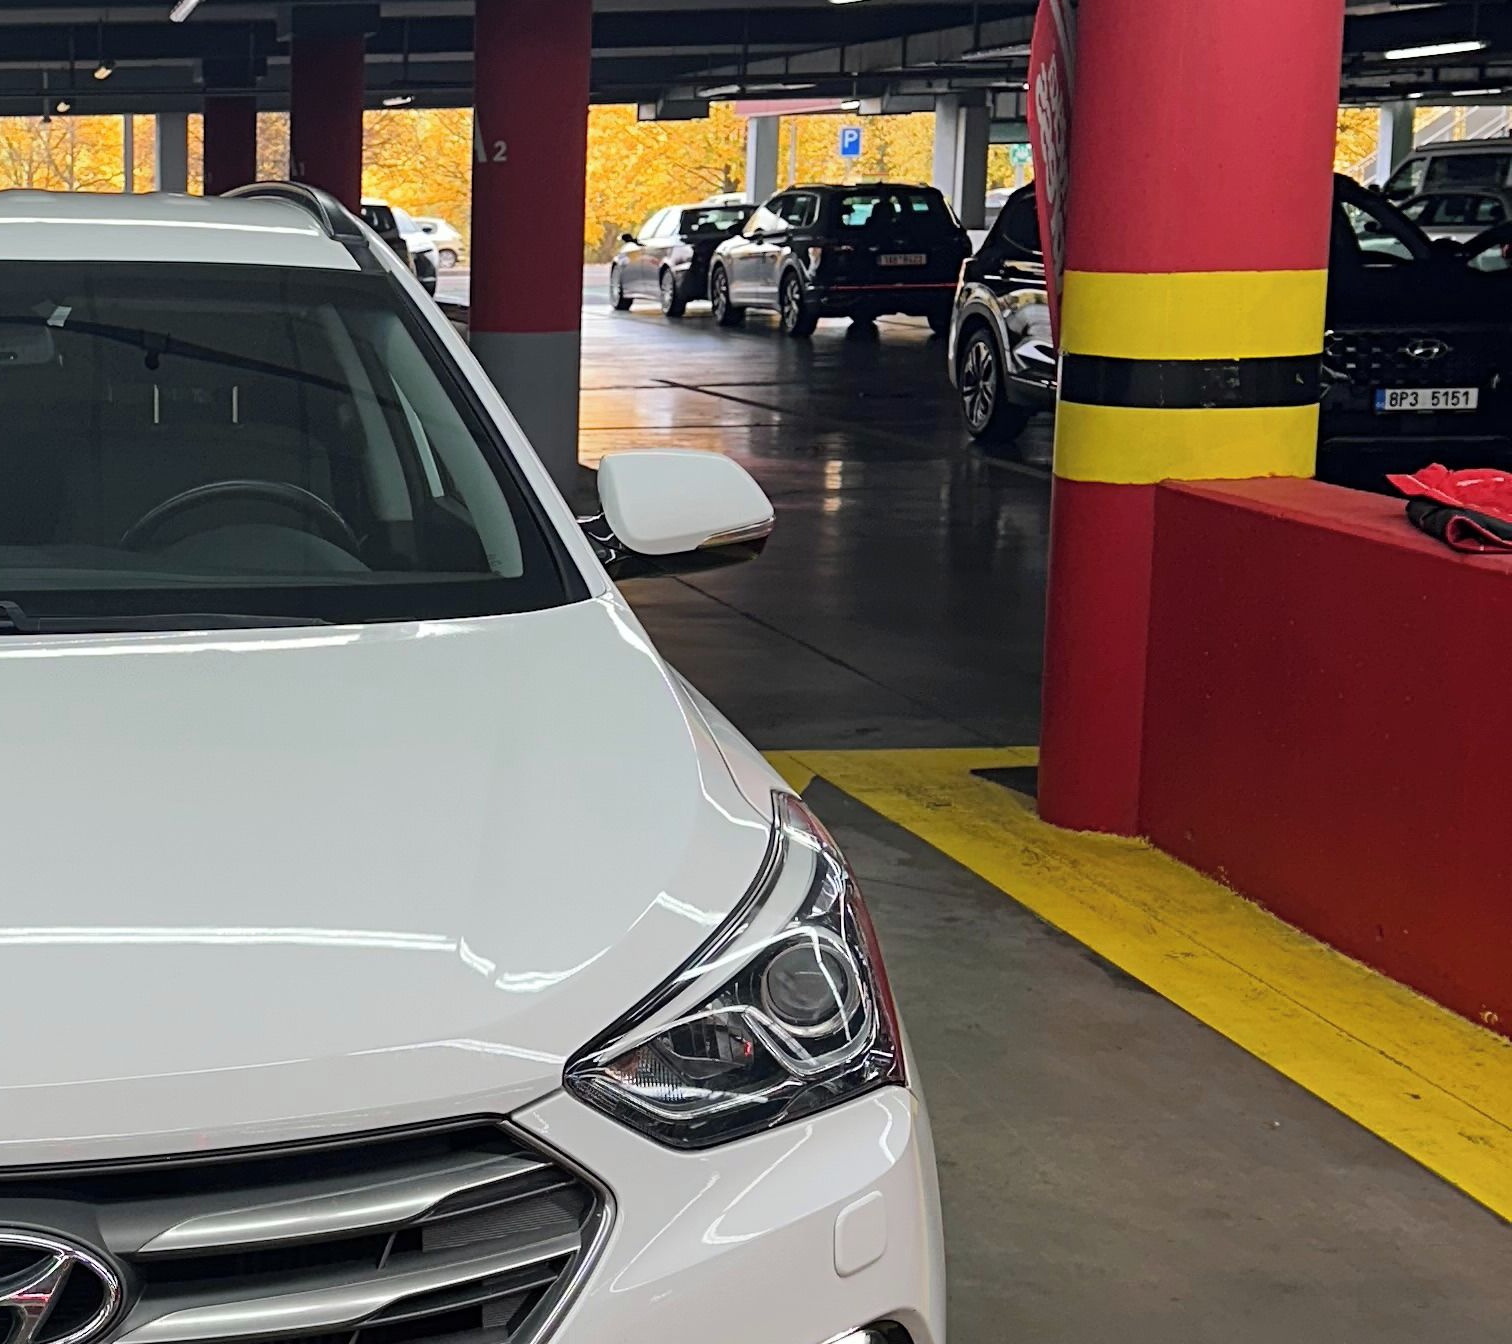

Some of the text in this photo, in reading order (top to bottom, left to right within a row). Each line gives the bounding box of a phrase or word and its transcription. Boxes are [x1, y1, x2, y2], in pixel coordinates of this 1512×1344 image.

[844, 129, 858, 148] P
[1389, 391, 1419, 407] 8P3
[1431, 390, 1470, 406] 5151
